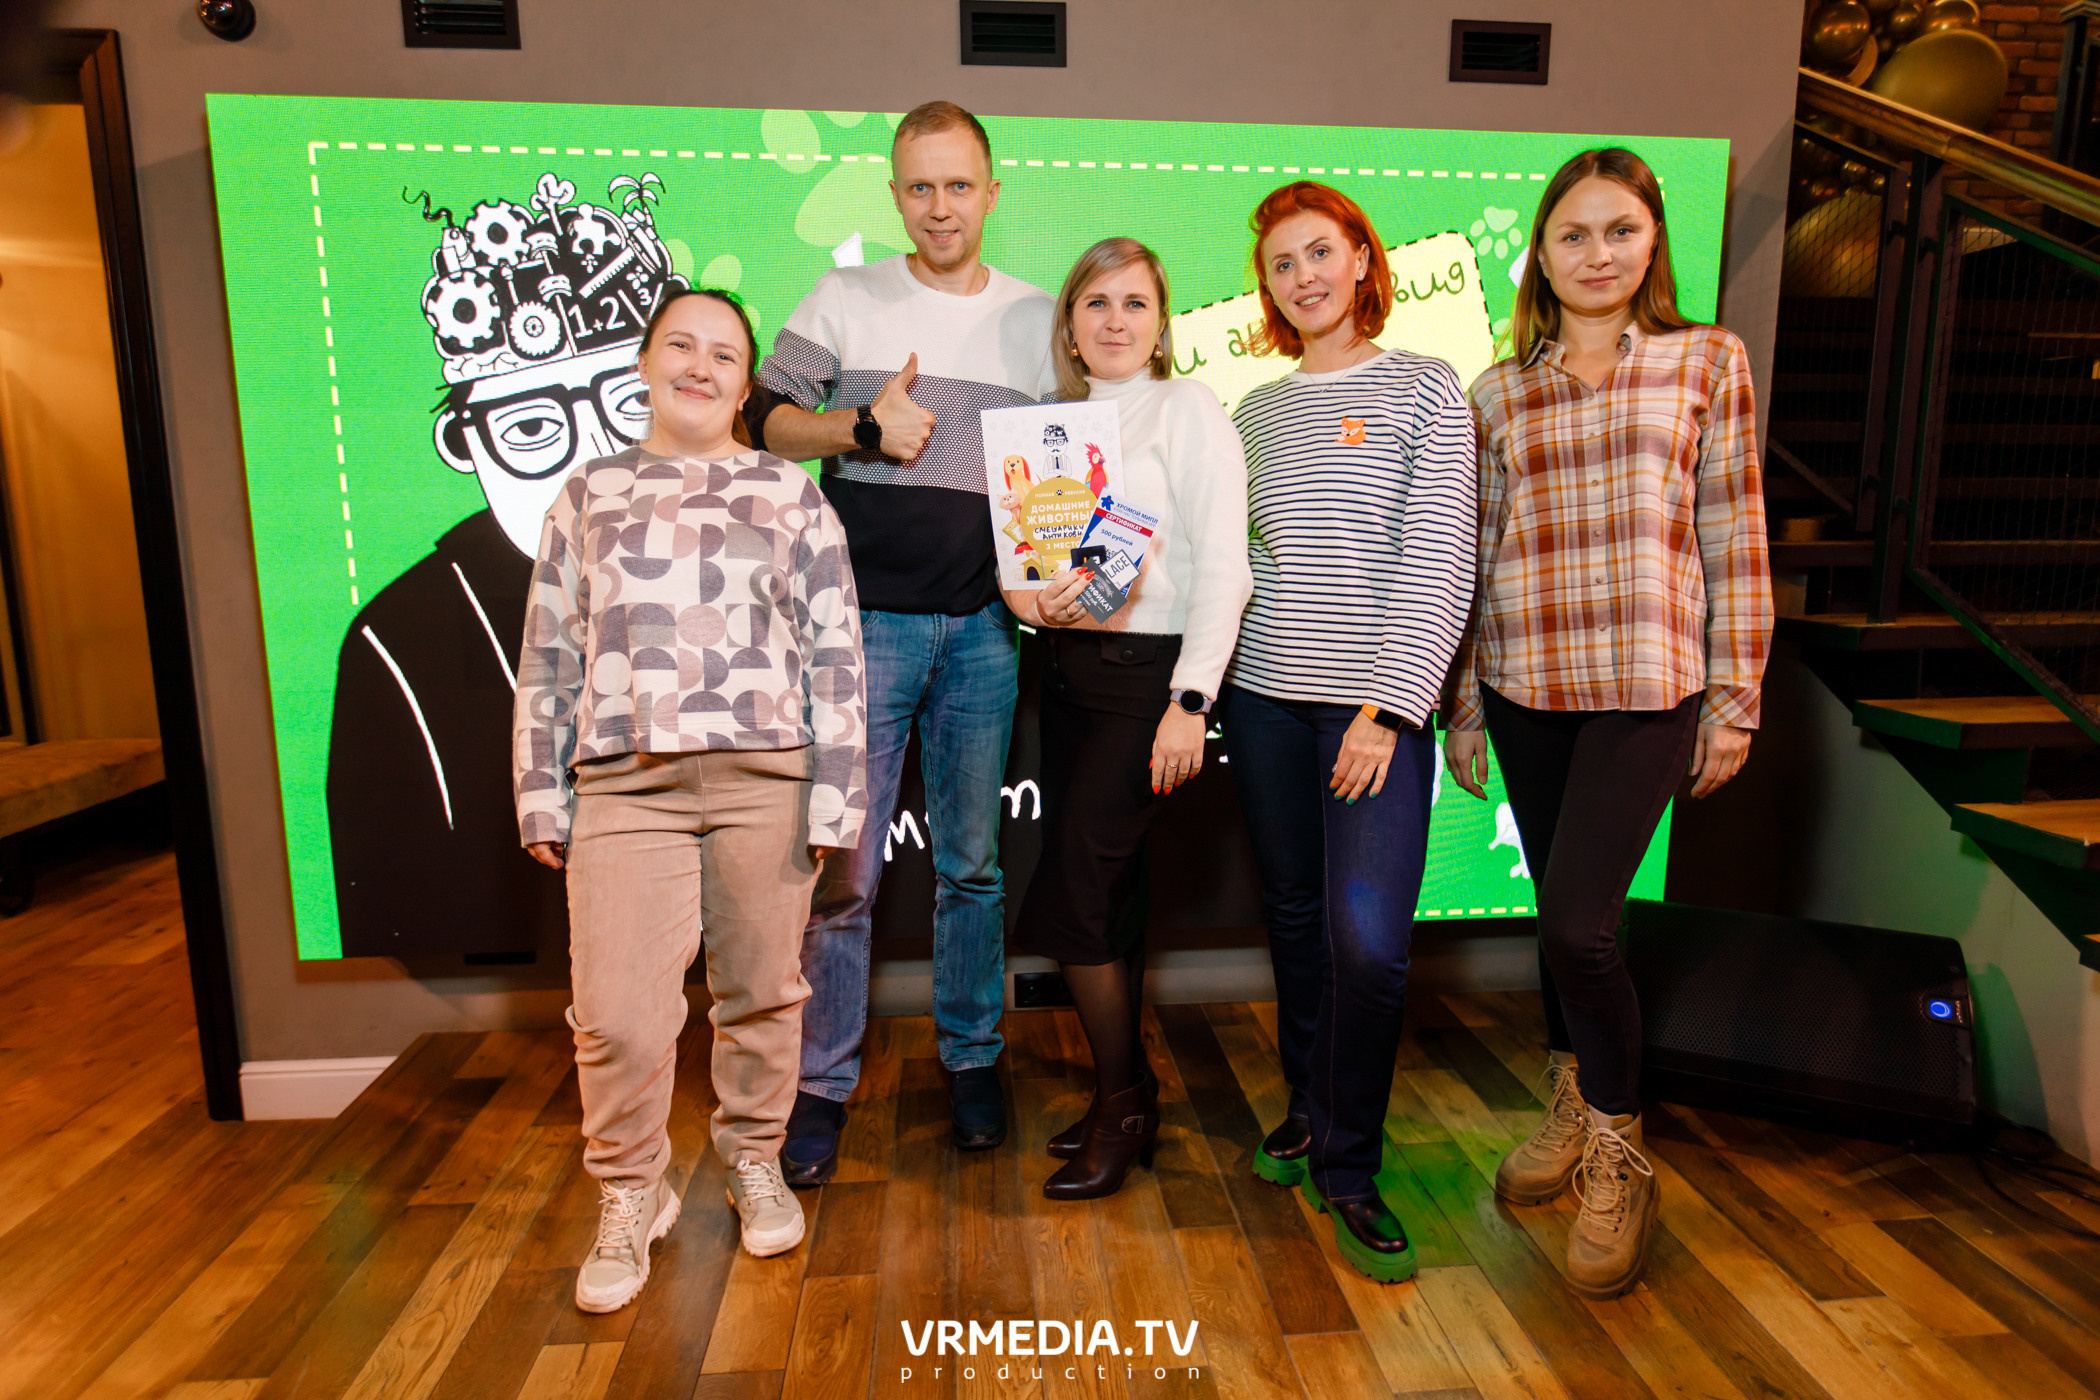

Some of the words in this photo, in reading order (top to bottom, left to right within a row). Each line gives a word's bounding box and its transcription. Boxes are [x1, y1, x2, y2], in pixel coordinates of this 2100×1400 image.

[1031, 500, 1090, 514] ДОМАШНИЕ
[1116, 502, 1141, 517] ХРОМОЙ
[1105, 513, 1143, 532] СЕРТИФИКАТ
[1101, 528, 1112, 537] 500
[1111, 533, 1133, 546] рублей
[1053, 541, 1080, 549] МЕСТО
